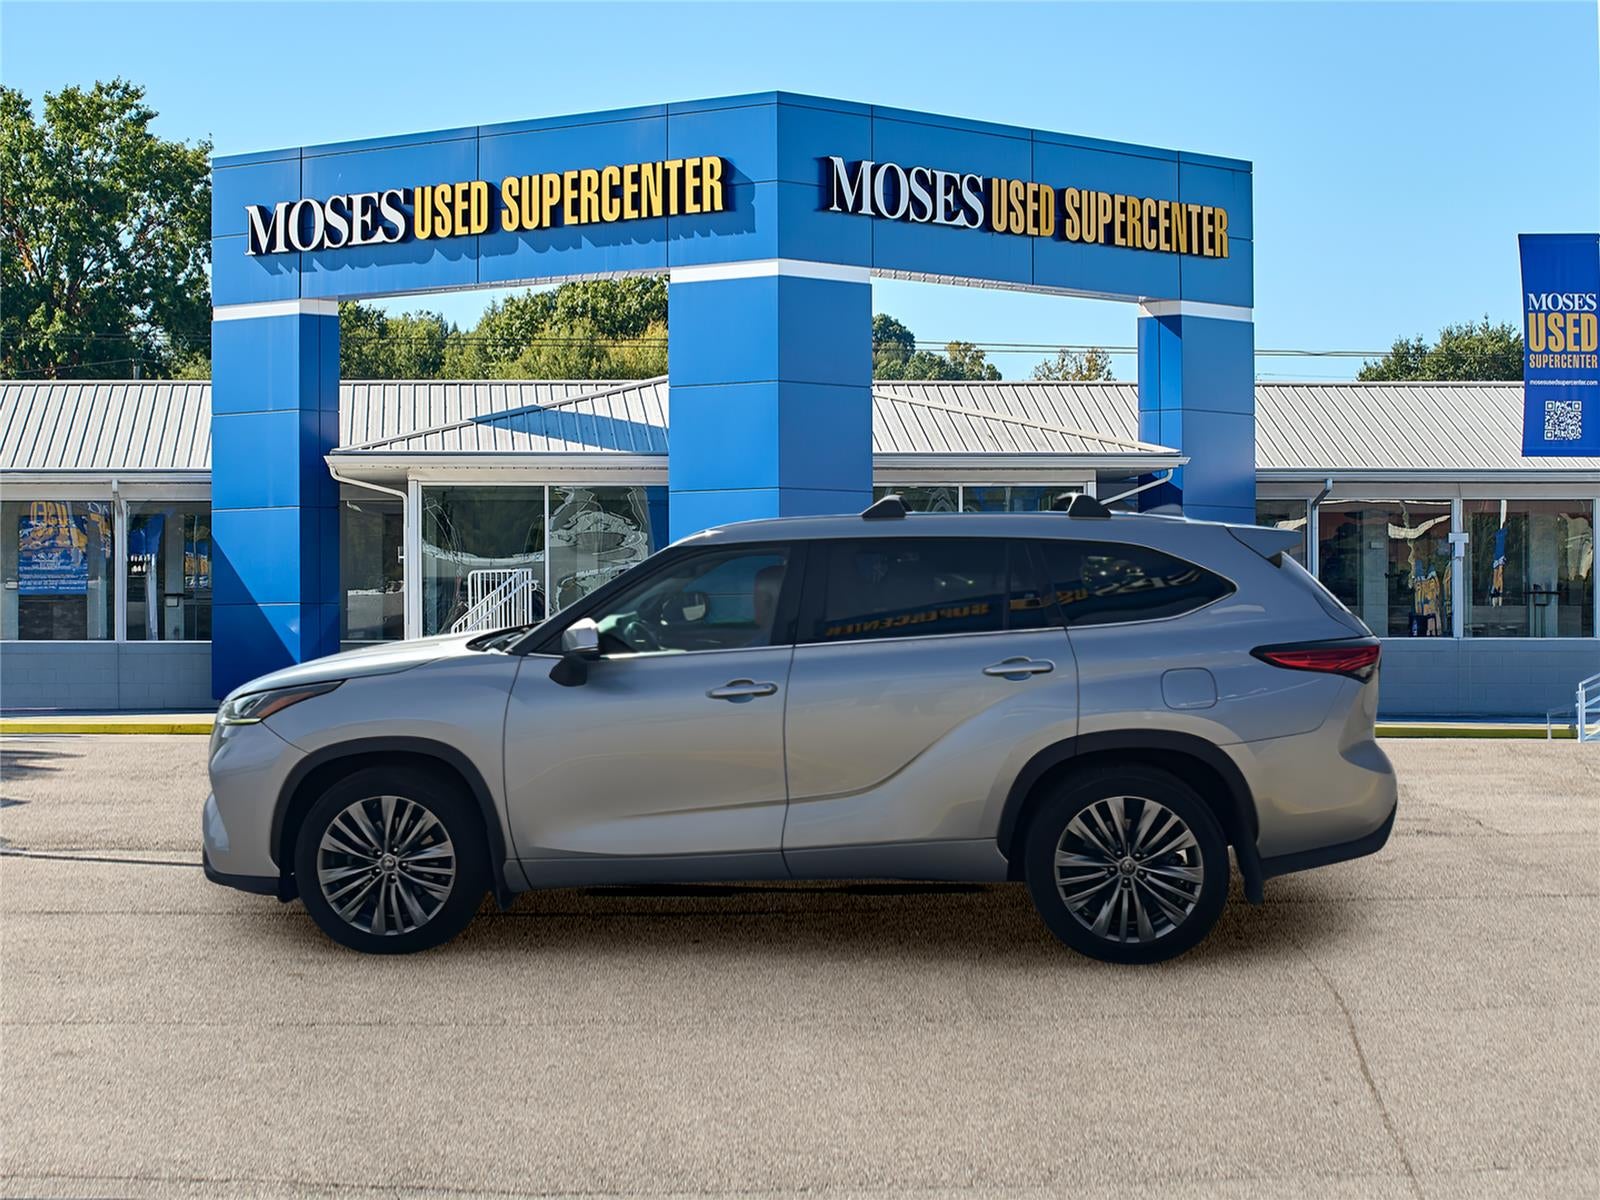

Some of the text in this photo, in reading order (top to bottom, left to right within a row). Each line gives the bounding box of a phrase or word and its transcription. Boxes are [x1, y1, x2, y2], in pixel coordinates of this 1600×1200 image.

[244, 156, 724, 256] MOSES USED SUPERCENTER
[829, 156, 1230, 258] MOSES USED SUPERCENTER
[1527, 293, 1597, 312] MOSES
[1528, 313, 1598, 352] USED
[1529, 354, 1598, 369] SUPERCENTER
